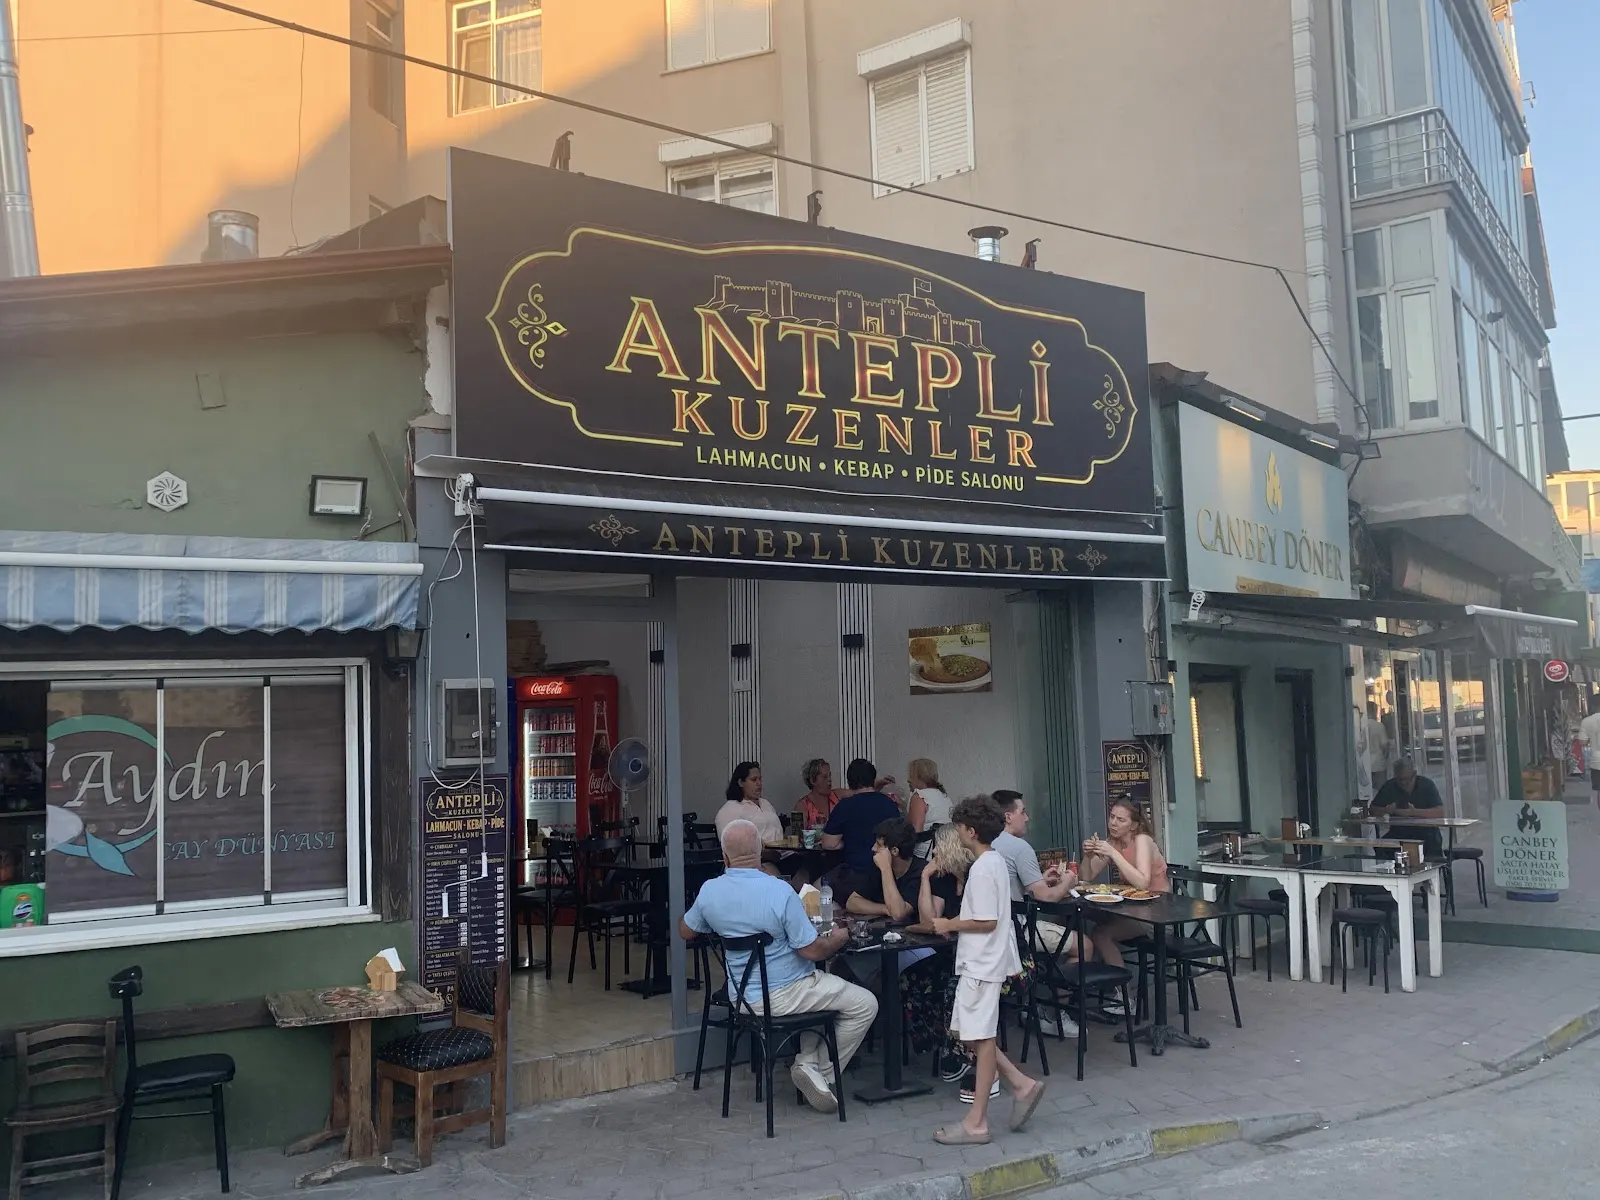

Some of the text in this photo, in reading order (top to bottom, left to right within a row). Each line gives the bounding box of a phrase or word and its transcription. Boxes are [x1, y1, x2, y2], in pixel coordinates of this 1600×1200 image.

[605, 296, 1054, 427] ANTEPLİ
[671, 388, 1037, 468] KUZENLER
[696, 446, 1026, 492] LAHMACUN KEBAP PİDE SALONU
[652, 521, 1069, 572] ANTEPLİ KUZENLER
[1197, 508, 1345, 581] CANBEY DÖNER
[61, 730, 277, 836] Aydın
[435, 791, 496, 809] ANTEPLİ
[214, 829, 336, 857] DÜNYASI
[425, 820, 463, 833] LAHMACUN
[490, 815, 505, 829] PİDE
[1501, 836, 1558, 847] CANBEY
[1503, 847, 1557, 861] DÖNER
